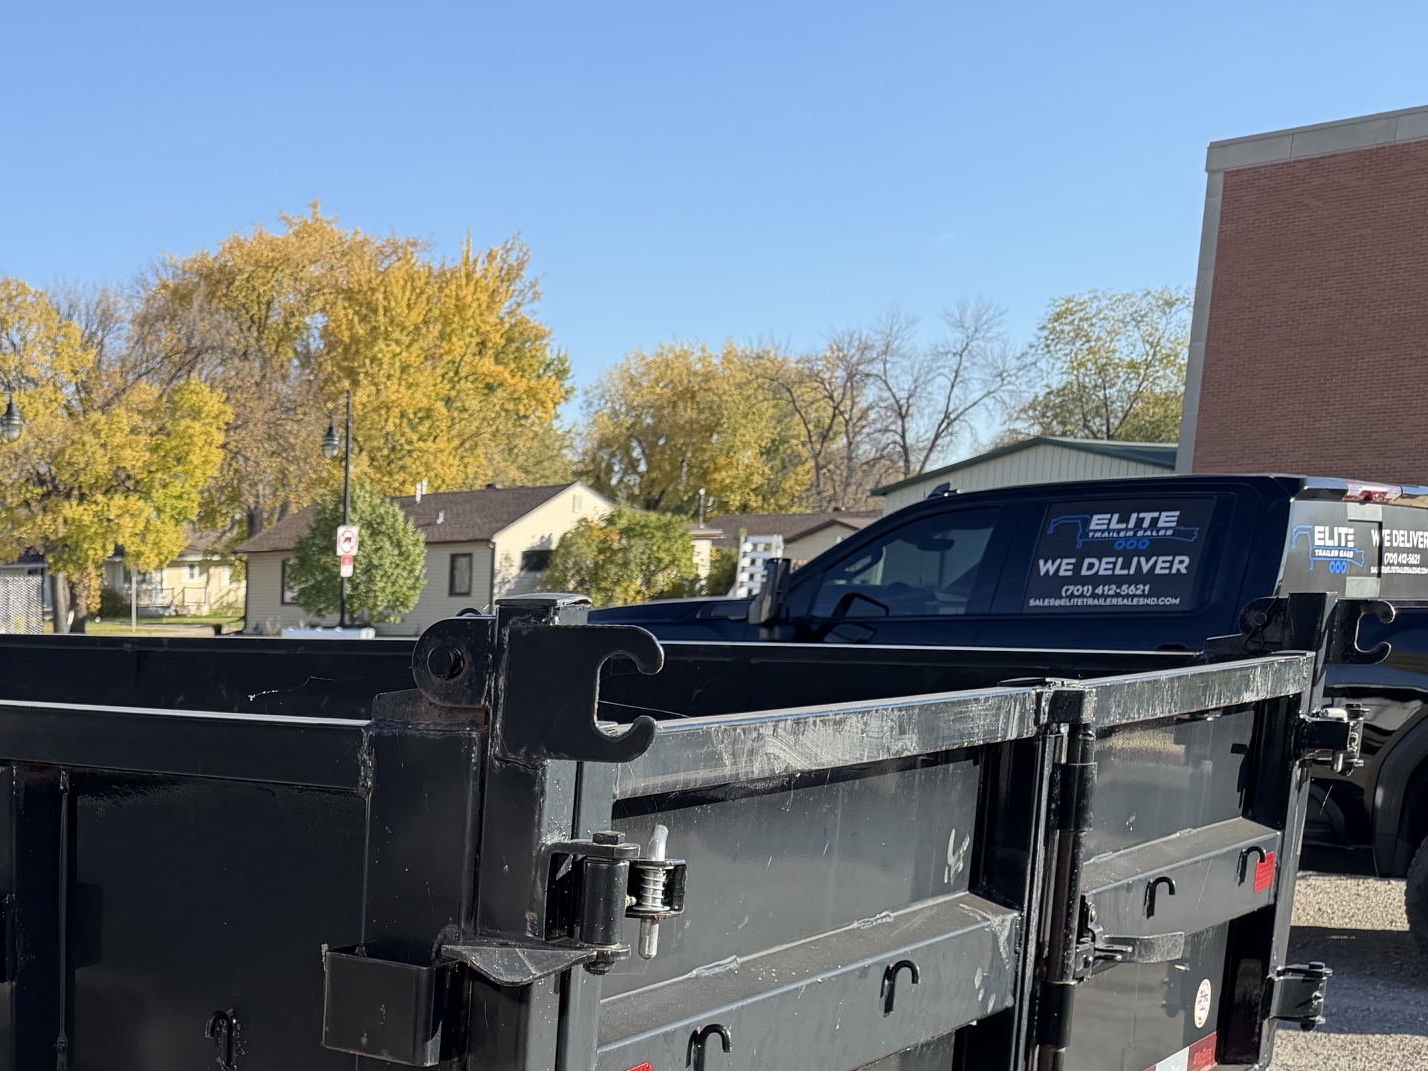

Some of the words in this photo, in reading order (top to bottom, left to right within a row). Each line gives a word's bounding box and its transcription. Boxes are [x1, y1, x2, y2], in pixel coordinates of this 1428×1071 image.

[1088, 511, 1180, 530] ELITE
[1136, 529, 1174, 537] SALES
[1314, 526, 1355, 548] ELITE
[1370, 529, 1391, 547] WE
[1391, 529, 1428, 549] DELIVER
[1038, 557, 1076, 577] WE
[1080, 555, 1191, 576] DELIVER
[1061, 584, 1093, 597] (701)
[1094, 583, 1150, 596] 412-5621
[1028, 596, 1181, 607] SALES@ELITETRAILERSALESND.COM
